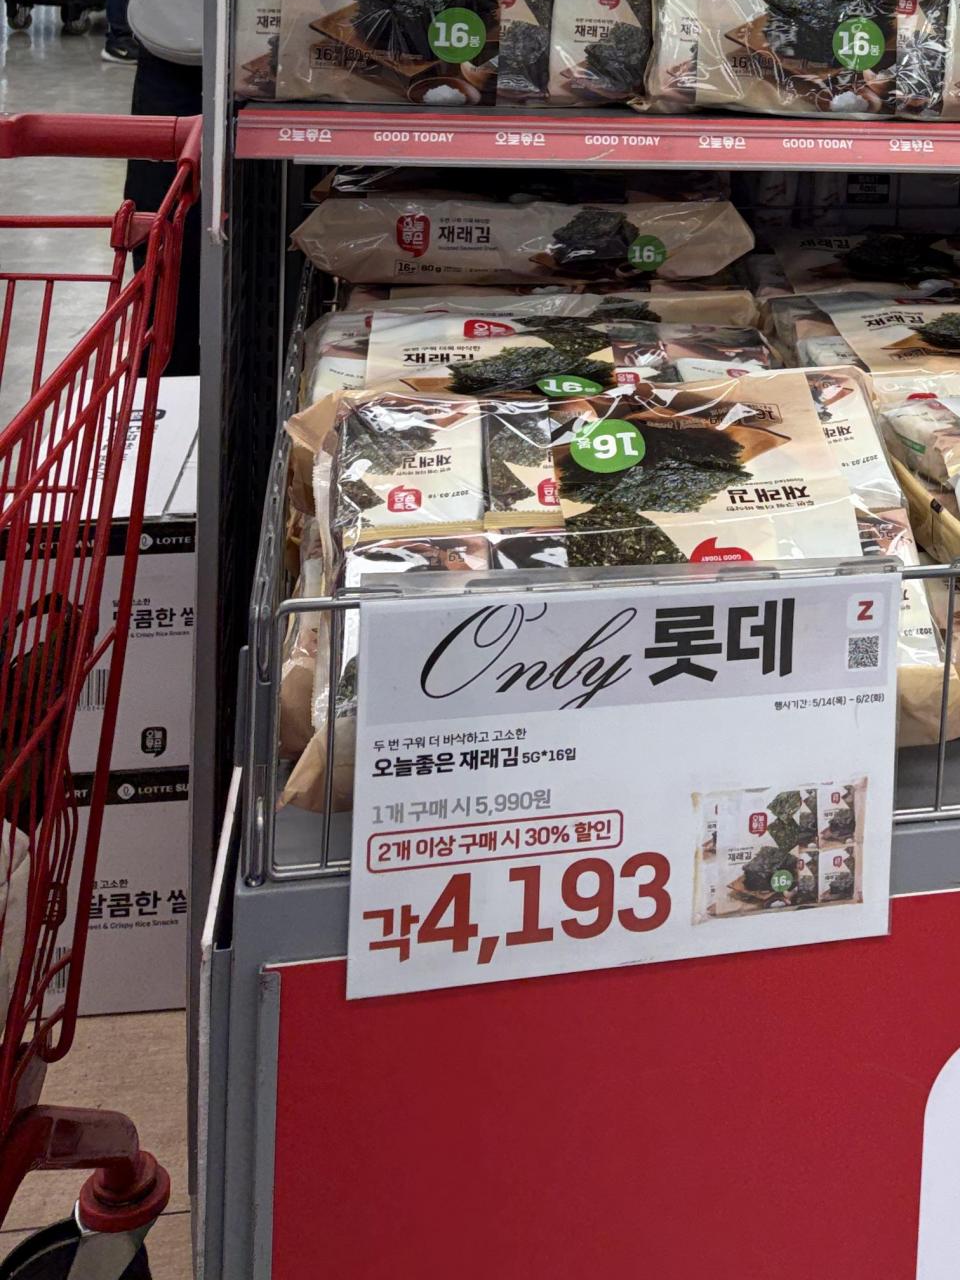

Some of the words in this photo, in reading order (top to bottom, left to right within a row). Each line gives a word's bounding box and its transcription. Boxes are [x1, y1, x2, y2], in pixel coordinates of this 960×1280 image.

[434, 21, 481, 49] 16봉
[574, 25, 610, 38] 재래김
[837, 31, 880, 57] 16봉
[278, 128, 332, 143] 오늘좋은
[373, 131, 410, 142] GOOD
[412, 132, 455, 143] TODAY
[495, 131, 545, 147] 오늘좋은
[584, 135, 619, 146] GOOD
[622, 135, 660, 146] TODAY
[698, 135, 746, 150] 오늘좋은
[782, 138, 814, 149] GOOD
[817, 139, 853, 149] TODAY
[888, 139, 935, 153] 오늘좋은
[437, 226, 491, 244] 재래김
[865, 315, 924, 327] 재래김
[576, 431, 638, 458] 16봉
[402, 454, 451, 469] 재래김
[727, 485, 811, 505] 재래김
[156, 535, 192, 545] LOTTE
[723, 553, 742, 561] GOOD
[420, 601, 637, 710] Only
[645, 598, 796, 688] 롯데
[373, 740, 385, 752] 두
[388, 739, 400, 751] 번
[402, 737, 425, 750] 구워
[429, 735, 440, 748] 더
[443, 731, 490, 746] 바삭하고
[492, 728, 527, 742] 고소한
[372, 751, 456, 778] 오늘좋은
[459, 746, 519, 770] 재래김
[138, 784, 173, 795] LOTTE
[372, 803, 404, 824] 1개
[408, 798, 449, 822] 구매
[451, 796, 471, 817] 시
[475, 788, 552, 816] 5,990원
[378, 839, 411, 863] 2개
[415, 835, 457, 858] 이상
[458, 831, 497, 854] 구매
[501, 828, 520, 849] 시
[524, 825, 570, 847] 30%
[574, 819, 612, 842] 할인
[101, 878, 129, 889] 고소한
[110, 922, 133, 930] Crispy
[135, 920, 151, 928] Rice
